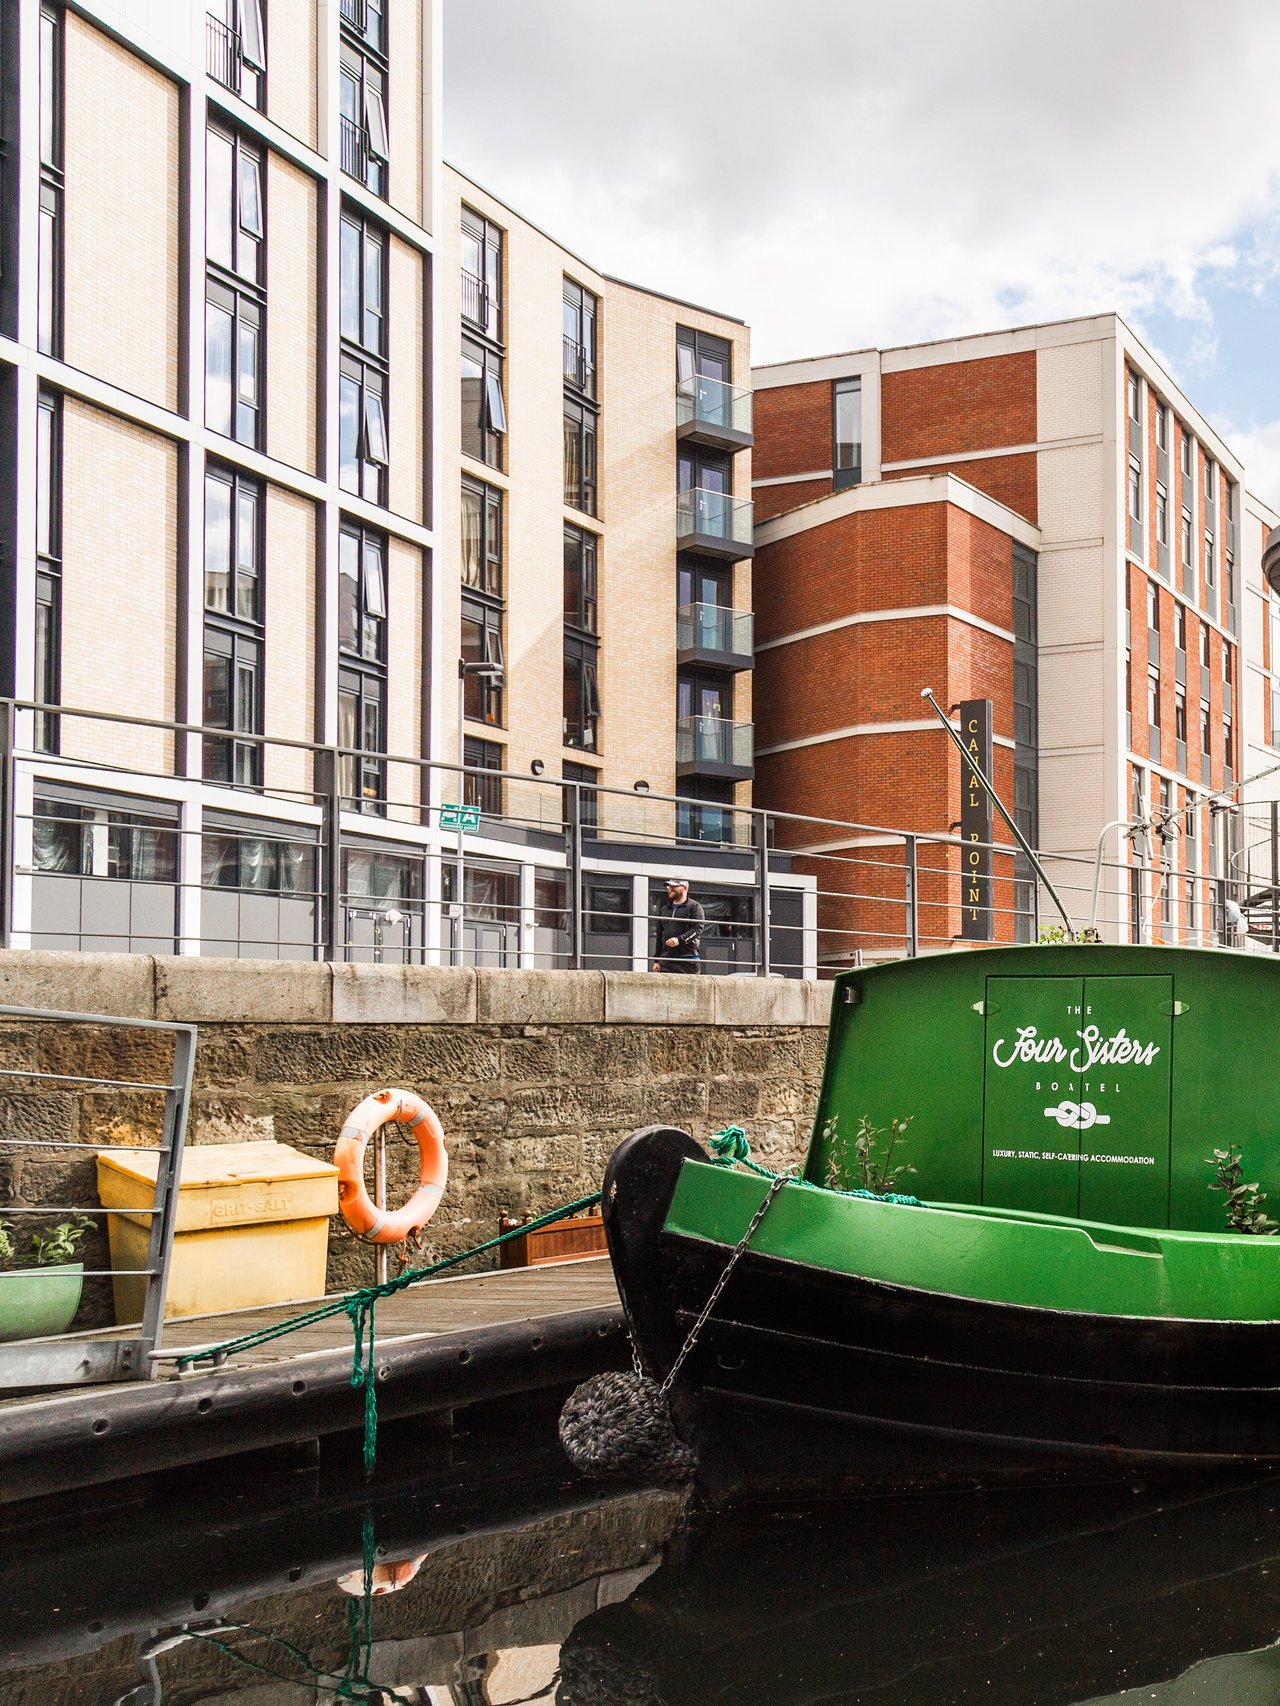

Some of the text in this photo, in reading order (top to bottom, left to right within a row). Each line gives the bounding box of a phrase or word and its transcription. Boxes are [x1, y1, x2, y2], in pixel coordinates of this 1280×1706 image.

[1066, 1005, 1092, 1015] THE
[992, 1024, 1160, 1073] Four Sisters
[1036, 1081, 1120, 1093] BOATEL
[992, 1149, 1155, 1165] LUXURY, STATIC, SELF-CATERING ACCOMMODATION
[213, 1198, 291, 1218] GRIT-SALT
